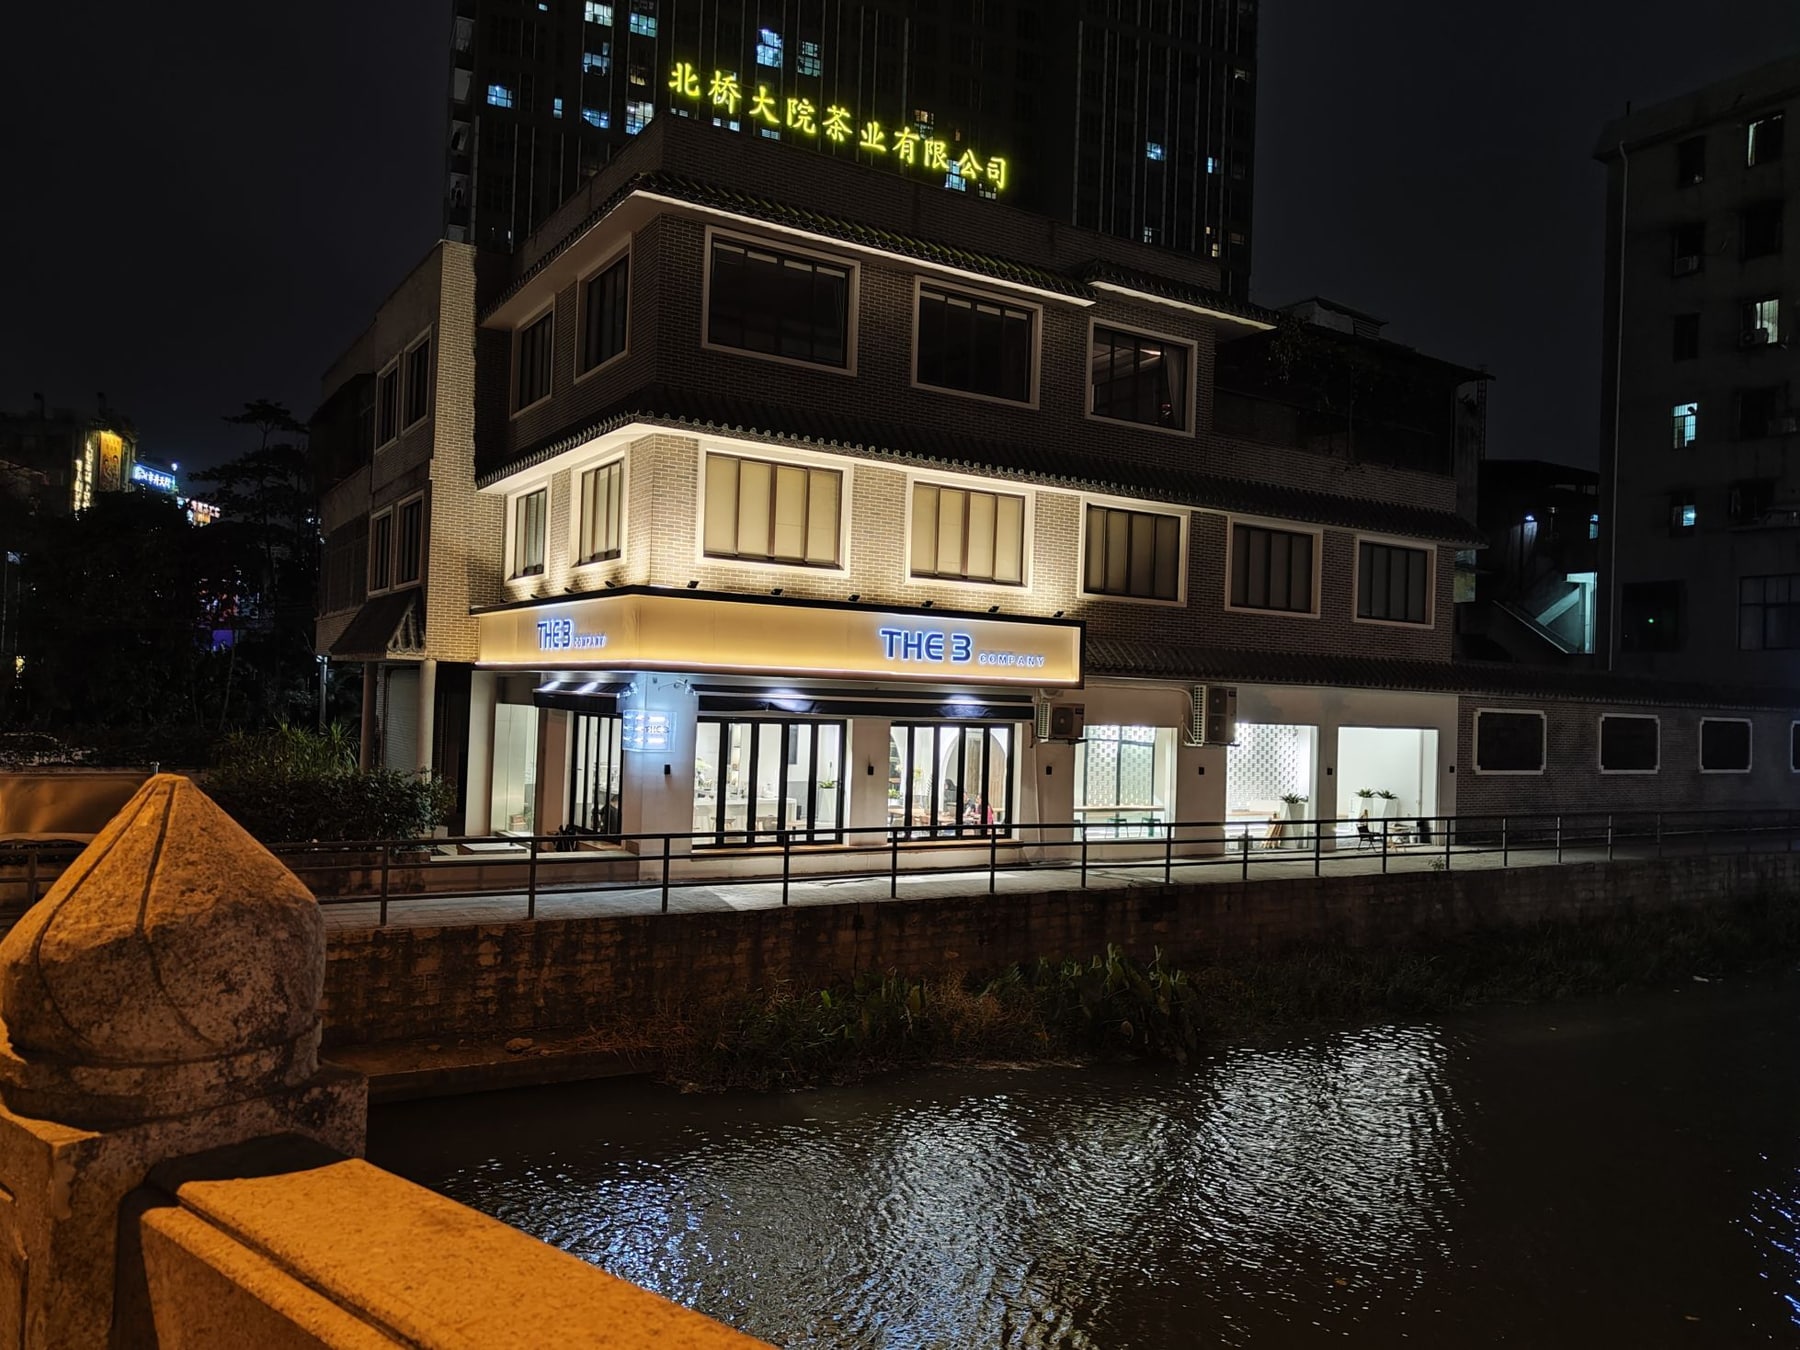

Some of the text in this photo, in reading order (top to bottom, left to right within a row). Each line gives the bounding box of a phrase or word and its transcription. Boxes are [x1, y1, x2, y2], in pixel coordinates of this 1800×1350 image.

[668, 61, 1007, 190] 北桥大院茶业有限公司
[537, 620, 561, 649] THE
[880, 629, 1045, 668] THE 3 COMPANY
